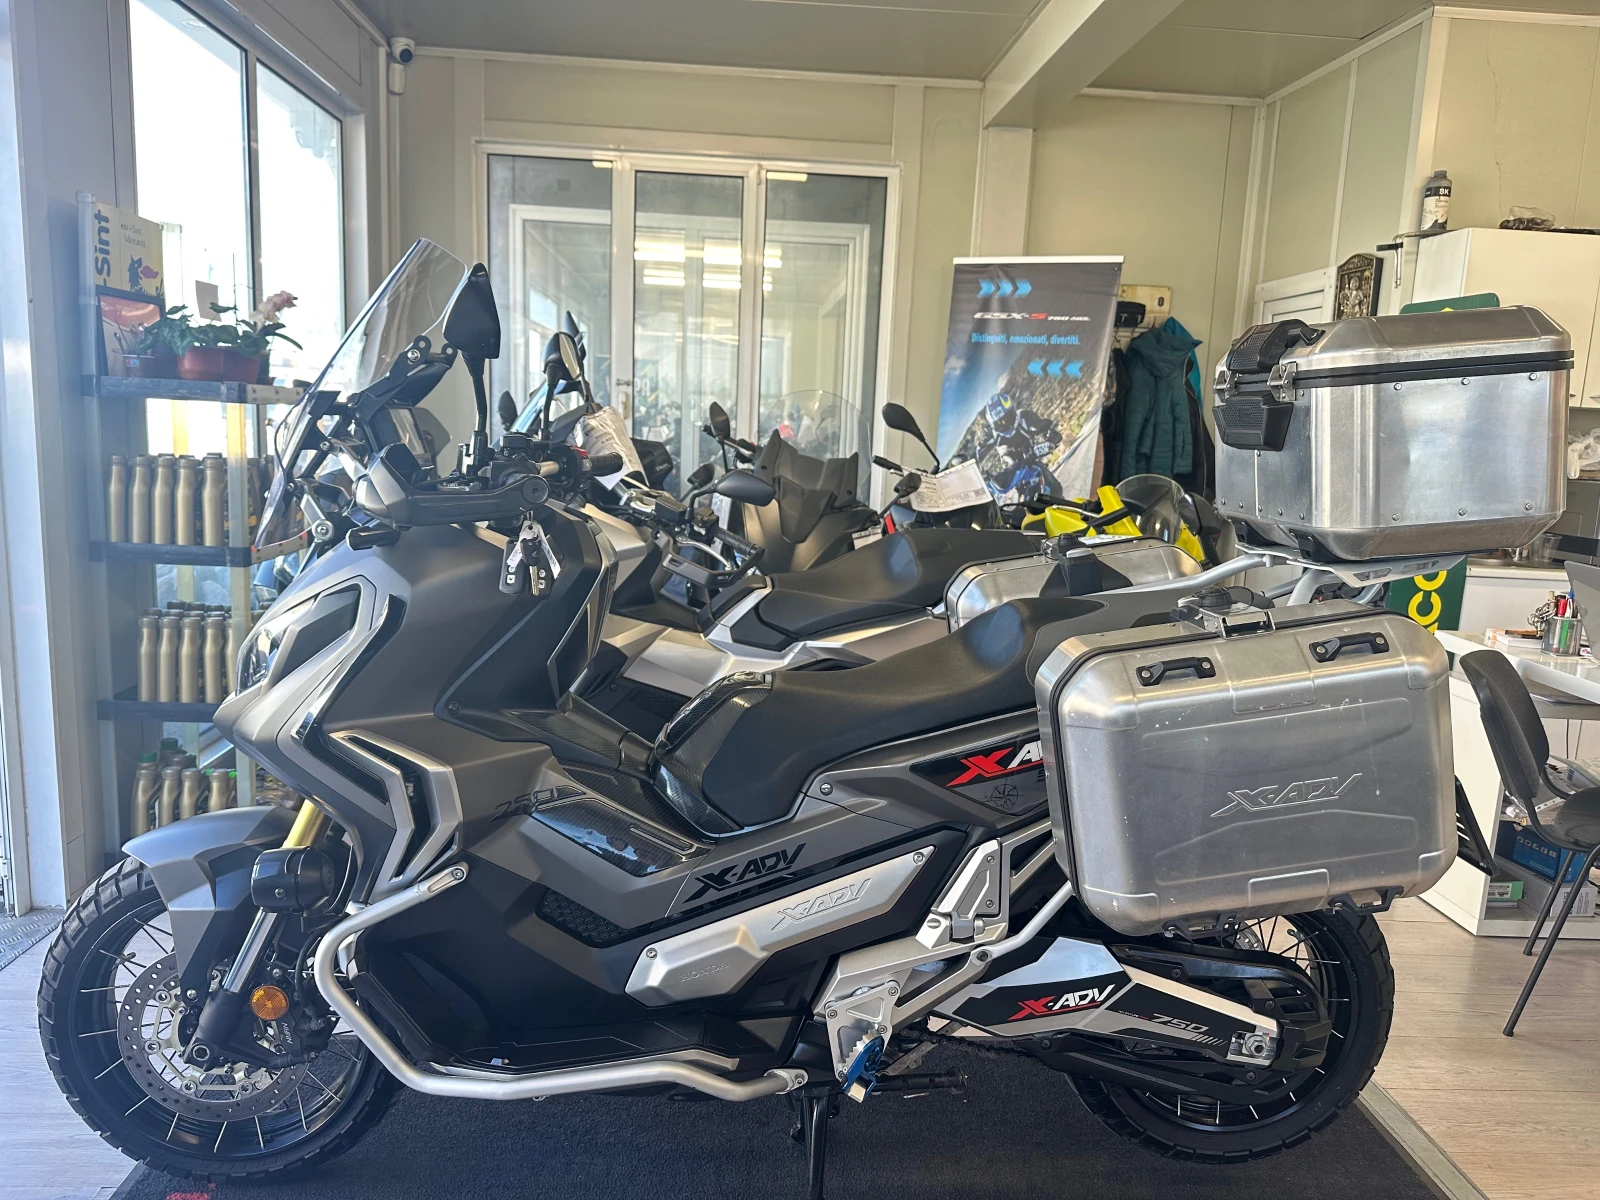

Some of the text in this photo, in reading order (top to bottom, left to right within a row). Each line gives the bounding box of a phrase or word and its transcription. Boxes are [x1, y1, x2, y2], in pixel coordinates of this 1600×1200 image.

[971, 332, 1081, 347] Distinguiti, emozionati, divertiti.
[1210, 772, 1363, 818] X-ADV
[682, 843, 807, 904] X-ADV
[771, 877, 872, 932] X-ADV
[1007, 983, 1116, 1021] X-ADV
[1149, 1013, 1209, 1034] 750
